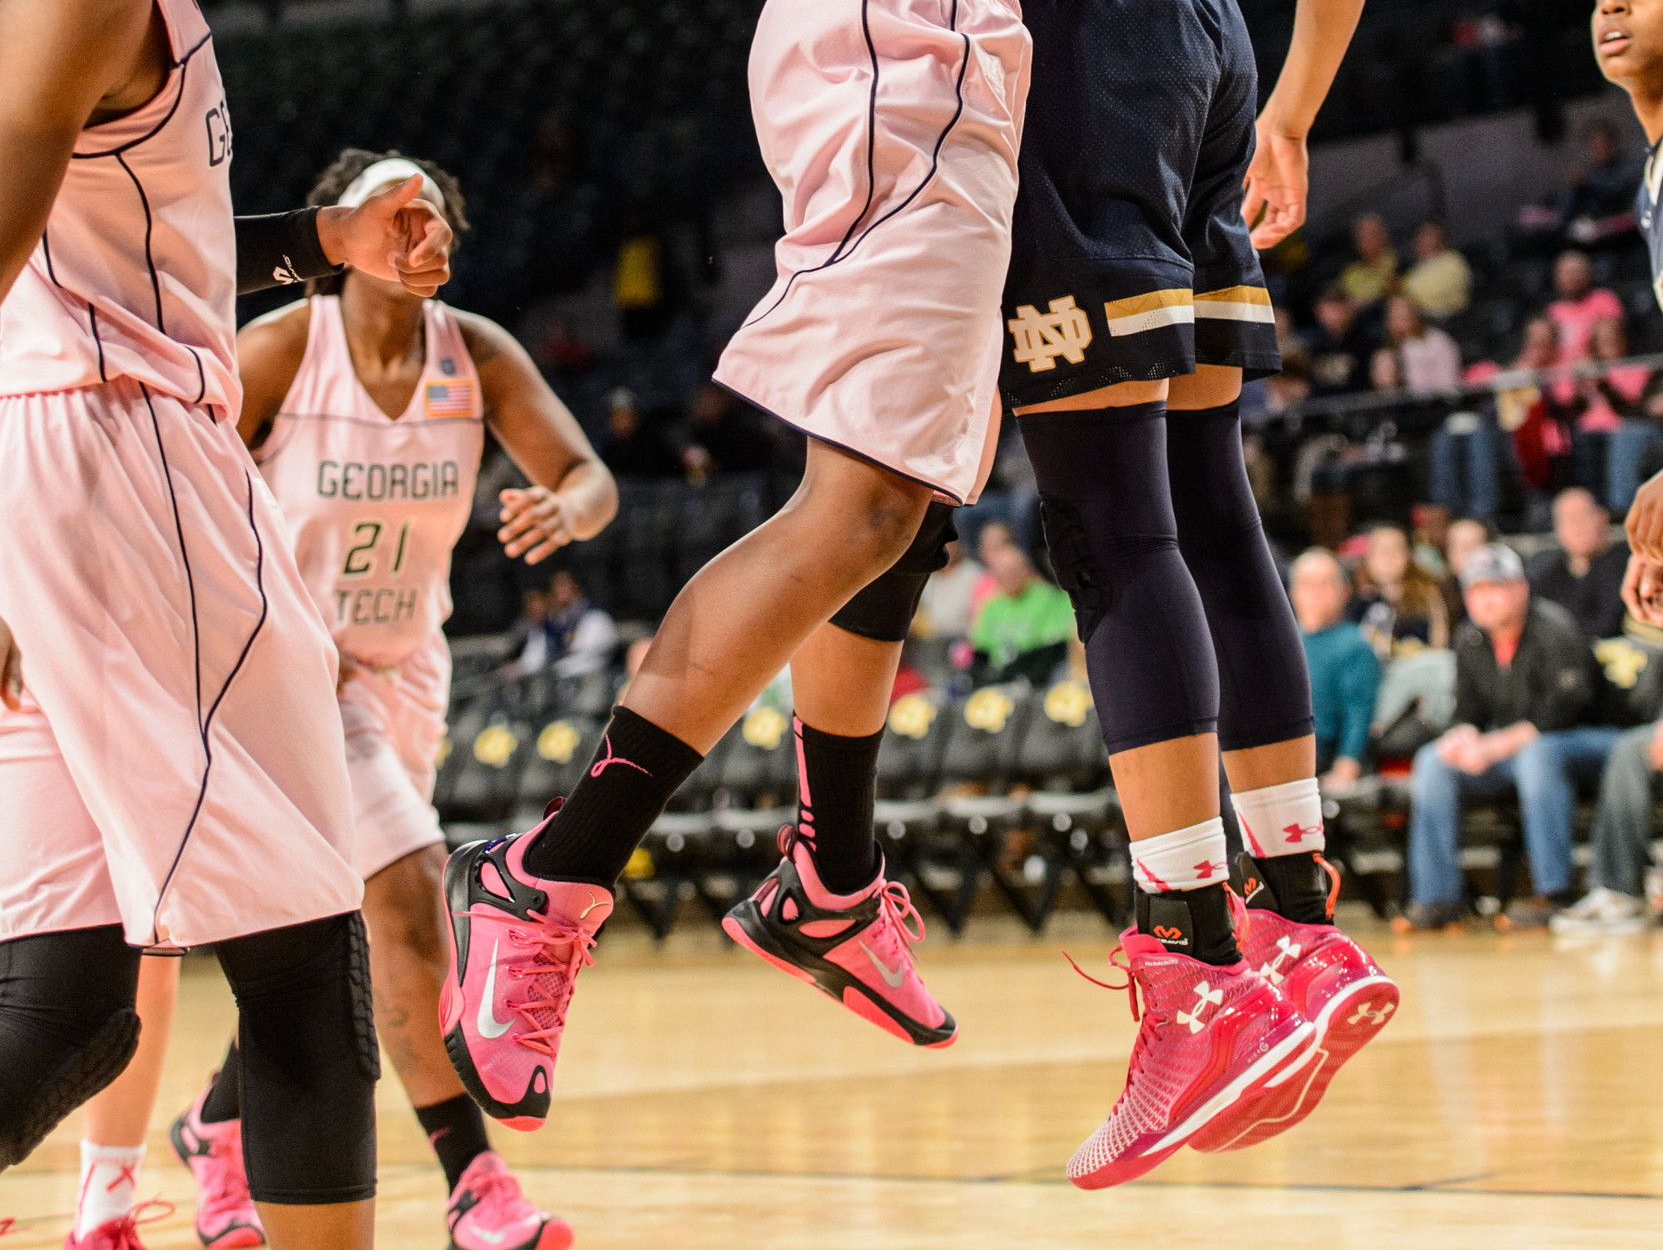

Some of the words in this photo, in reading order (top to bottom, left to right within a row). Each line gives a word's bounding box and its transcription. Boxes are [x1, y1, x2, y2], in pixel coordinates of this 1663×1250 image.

[318, 461, 458, 500] GEORGIA
[342, 521, 410, 576] 21
[334, 587, 417, 626] TECH
